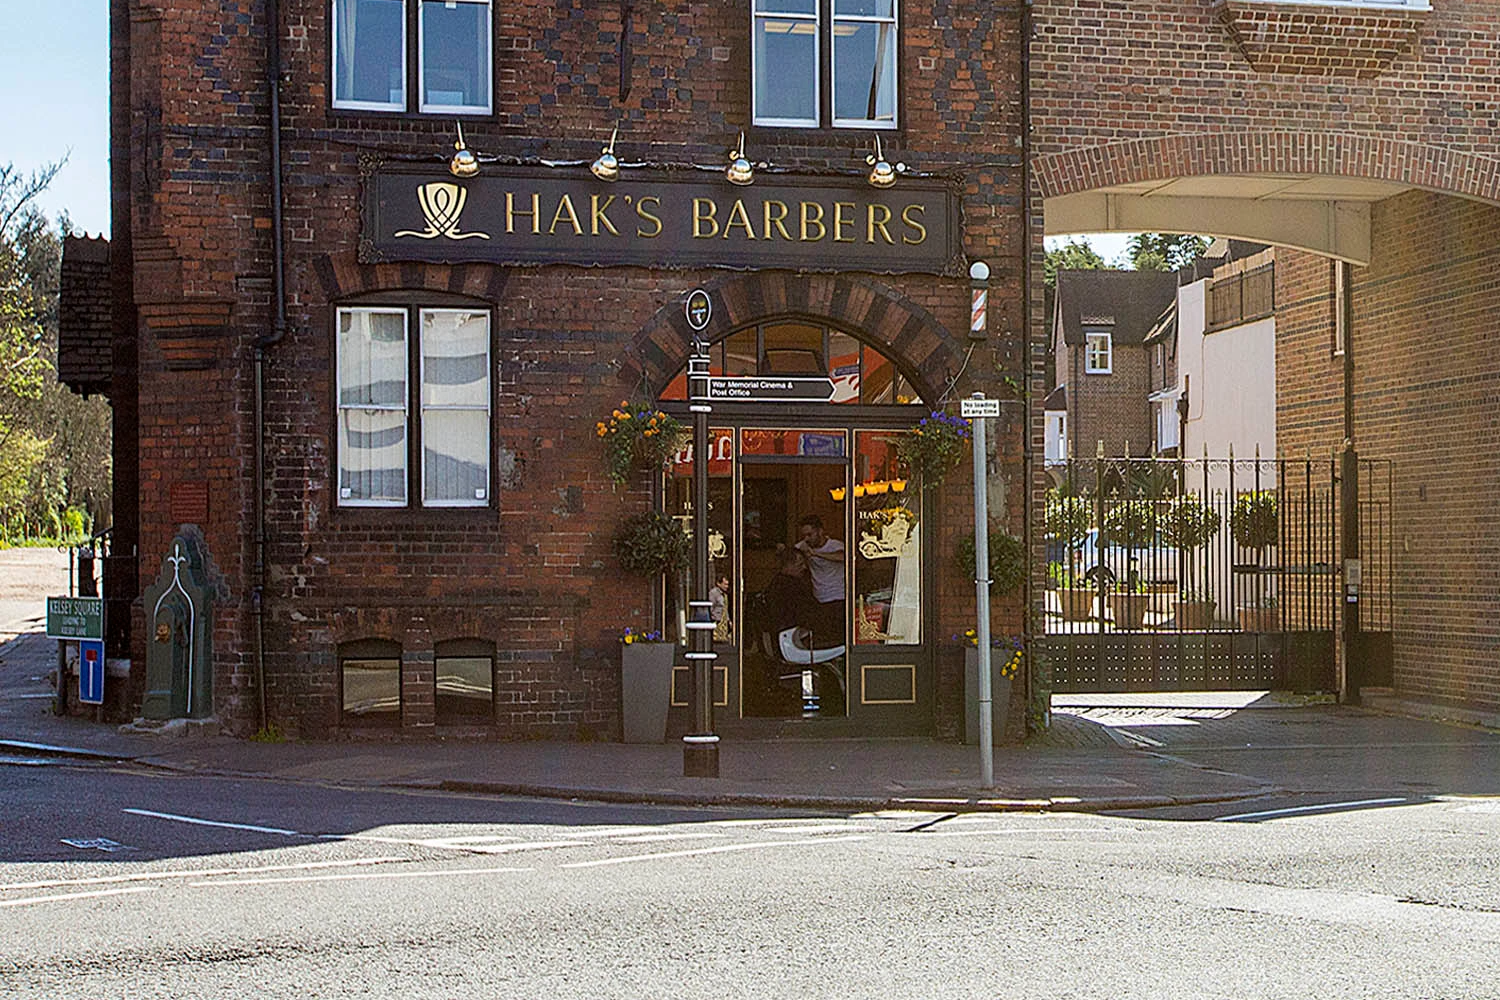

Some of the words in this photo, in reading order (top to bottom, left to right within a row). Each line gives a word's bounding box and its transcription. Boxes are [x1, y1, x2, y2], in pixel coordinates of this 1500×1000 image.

[504, 192, 664, 238] HAK'S
[691, 198, 928, 246] BARBERS
[760, 381, 786, 389] Cinema
[50, 600, 72, 615] KELSEY
[74, 600, 100, 616] SQUARE
